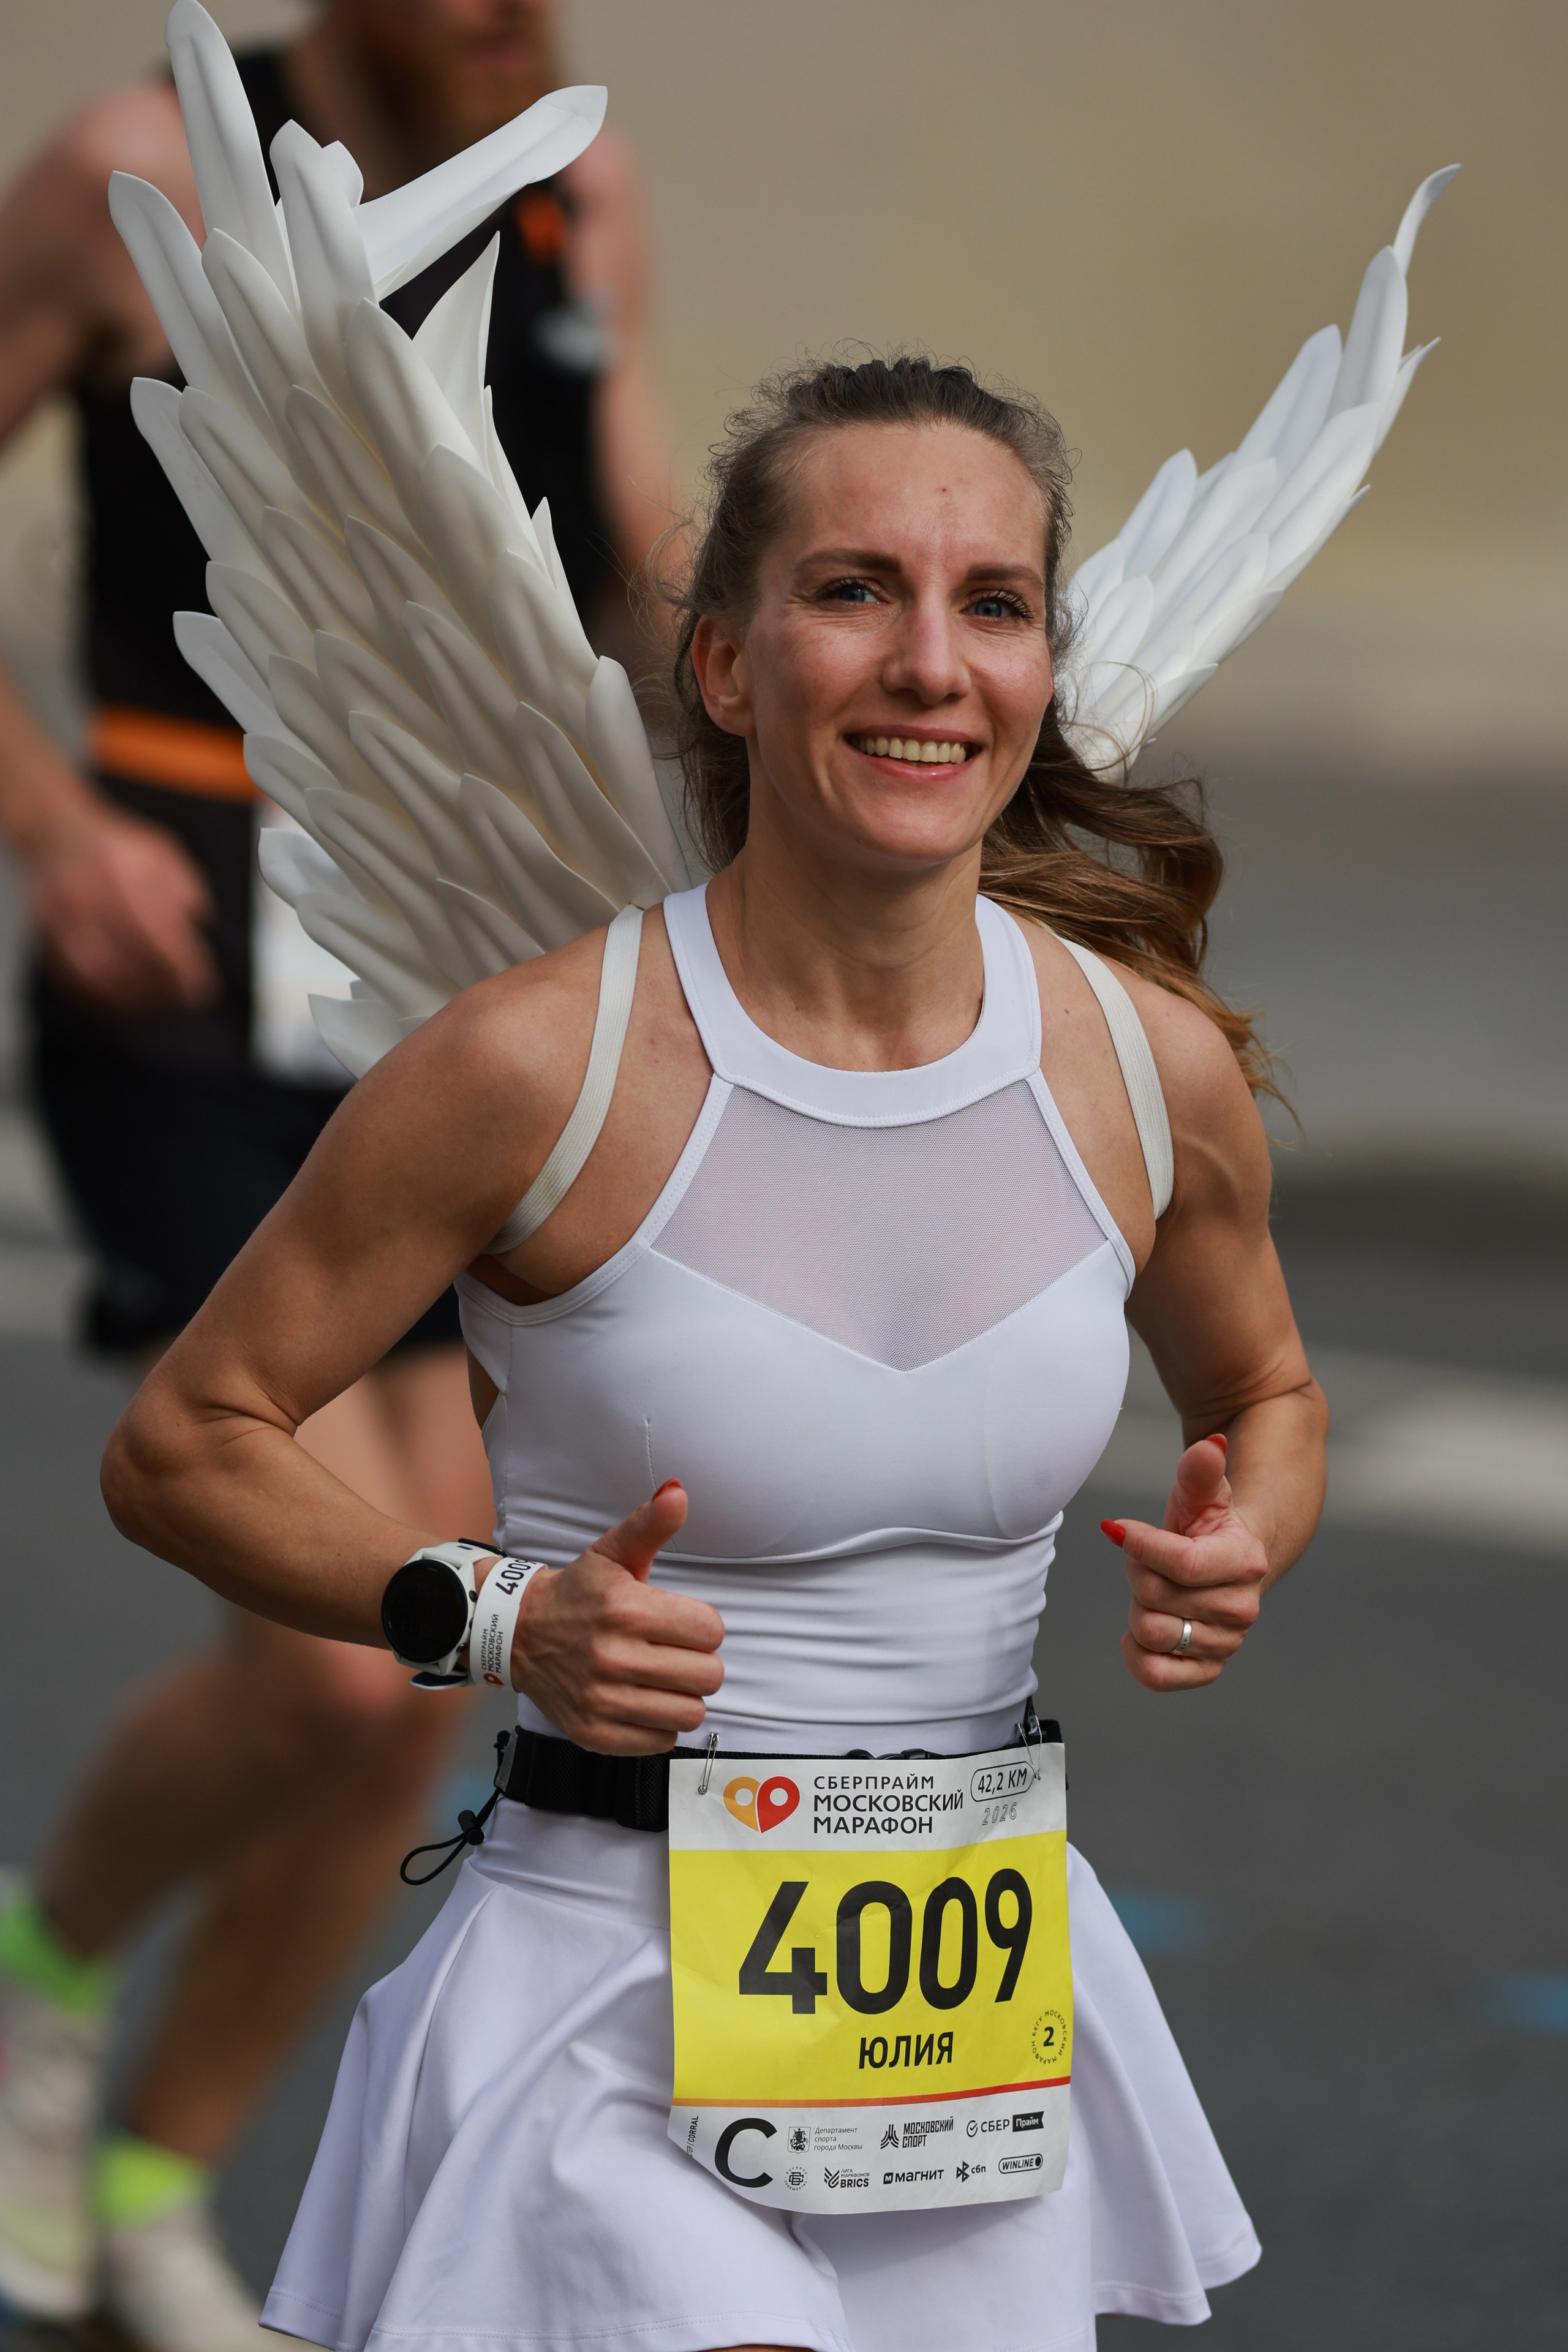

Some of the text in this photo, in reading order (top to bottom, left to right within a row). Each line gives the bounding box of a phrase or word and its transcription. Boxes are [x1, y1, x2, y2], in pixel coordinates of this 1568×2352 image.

[488, 1614, 499, 1672] МОСКОВСКИЙ
[495, 1632, 503, 1673] МАРАФОН
[813, 1773, 933, 1790] СБЕРПРАЙМ
[978, 1772, 1004, 1794] 42,2
[813, 1789, 963, 1812] МОСКОВСКИЙ
[982, 1802, 1017, 1826] 2026
[813, 1816, 933, 1834] МАРАФОН
[739, 1868, 1033, 2015] 4009
[1043, 2026, 1054, 2047] 2
[1044, 2010, 1067, 2056] МОСКОВСКИЙ
[859, 2032, 954, 2069] ЮЛИЯ
[1031, 2040, 1057, 2064] МАРАФОН
[688, 2116, 699, 2143] CORRAL
[903, 2116, 954, 2135] МОСКОВСКИЙ
[981, 2119, 1010, 2133] СБЕР
[1016, 2116, 1039, 2128] Прайм
[902, 2135, 927, 2148] СПОРТ
[971, 2165, 986, 2174] сбп
[1002, 2158, 1034, 2171] WINLINE
[840, 2178, 870, 2188] BRICS
